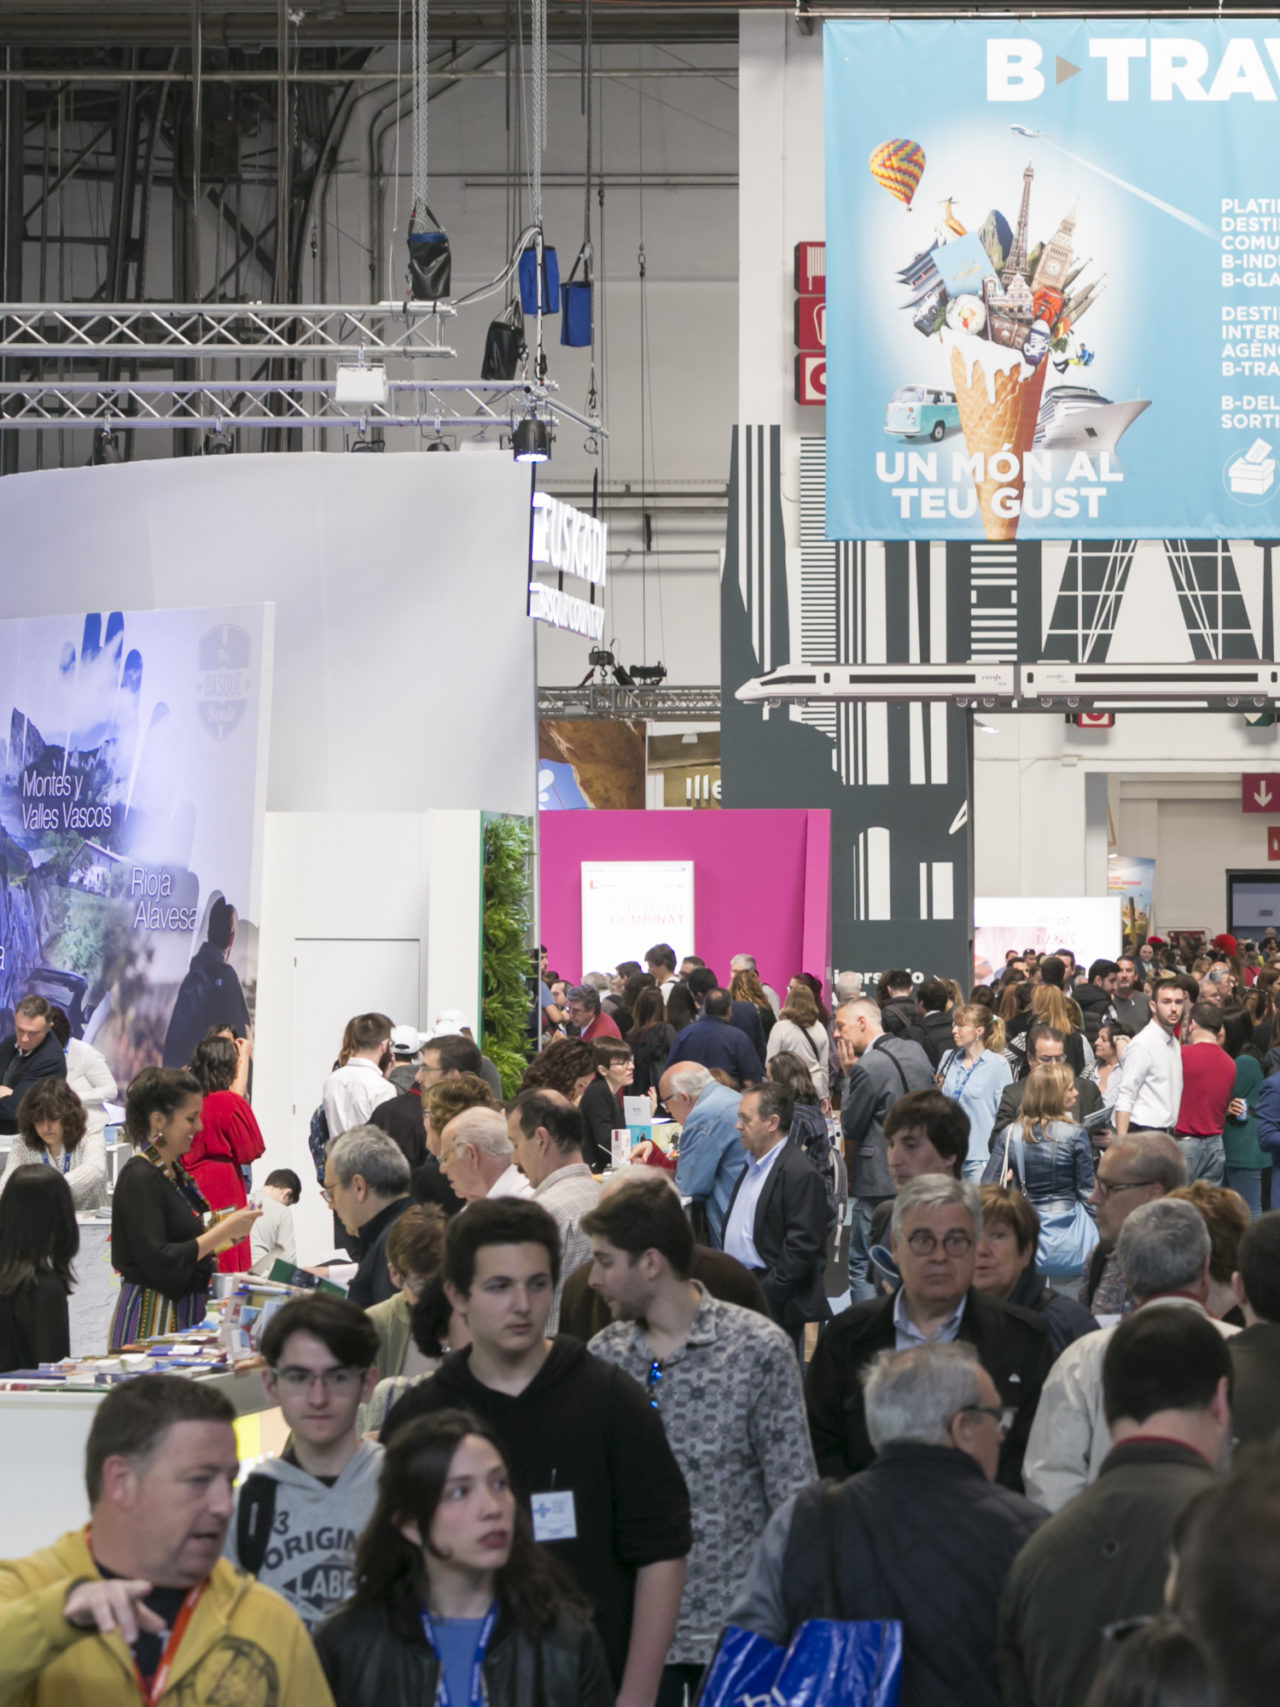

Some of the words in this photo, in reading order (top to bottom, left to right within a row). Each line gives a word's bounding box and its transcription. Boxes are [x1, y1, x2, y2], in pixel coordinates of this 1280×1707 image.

[986, 38, 1045, 101] B
[875, 452, 937, 482] UN
[952, 443, 1047, 482] MÓN
[1065, 452, 1124, 482] AL
[891, 488, 977, 518] TEU
[990, 487, 1107, 519] GUST
[532, 492, 607, 587] EUSKADI
[23, 770, 71, 798] Montes
[75, 775, 84, 802] y
[22, 803, 59, 830] Valles
[62, 801, 113, 829] Vascos
[131, 867, 172, 901] Rioja
[134, 900, 199, 930] Alavesa
